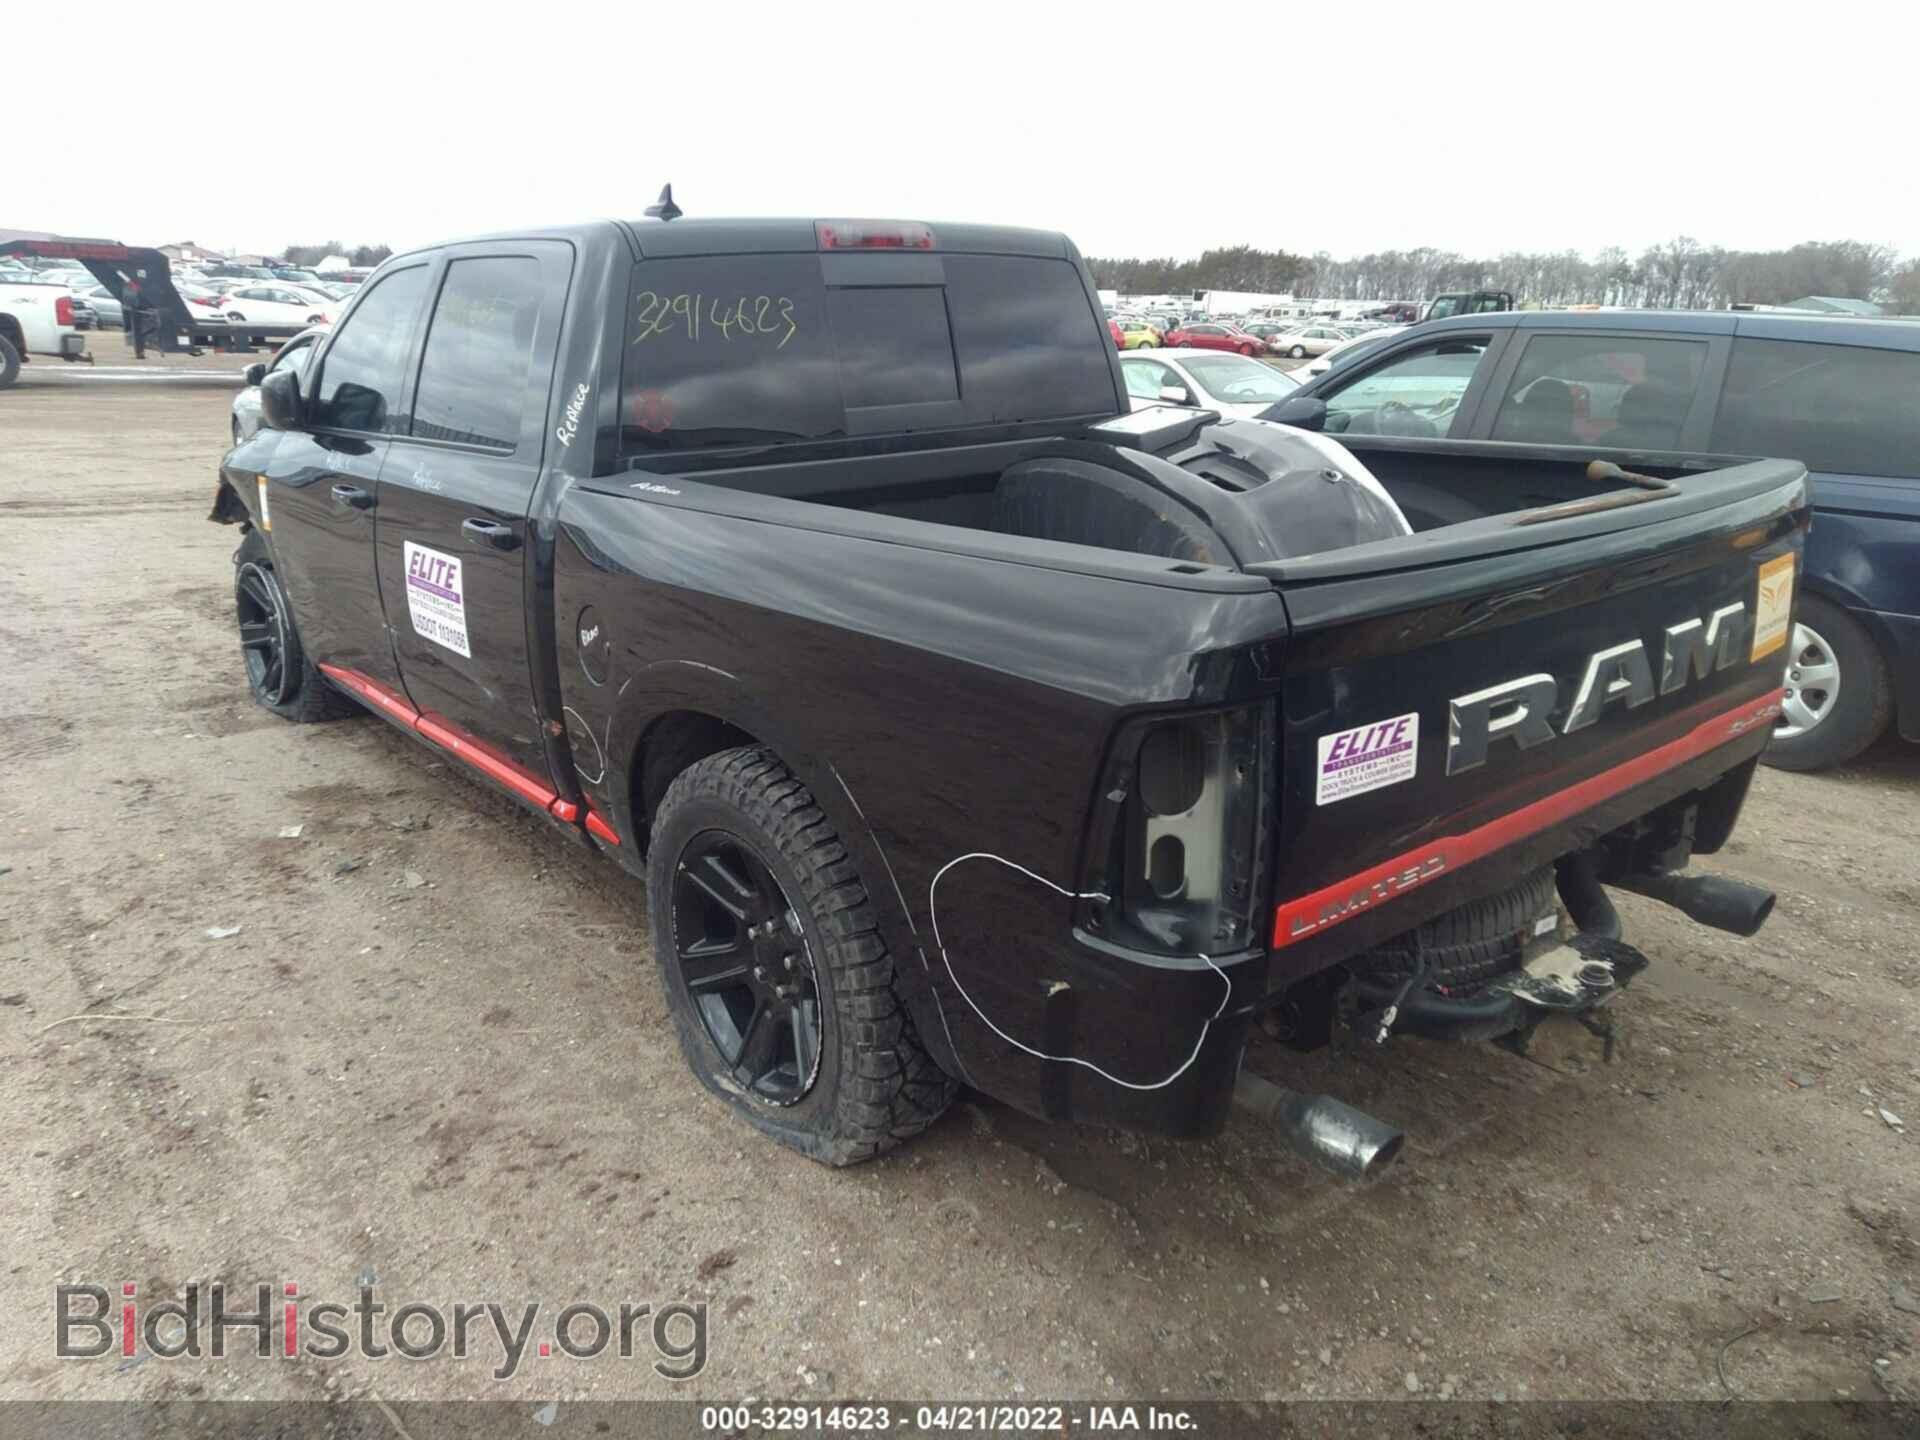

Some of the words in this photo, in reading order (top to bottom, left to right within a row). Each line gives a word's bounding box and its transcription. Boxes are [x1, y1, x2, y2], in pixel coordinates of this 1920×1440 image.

[632, 290, 797, 350] 32914623
[409, 550, 457, 590] ELITE
[1445, 601, 1745, 776] RAM
[1327, 717, 1411, 762] ELITE
[1291, 854, 1446, 937] LIMITED
